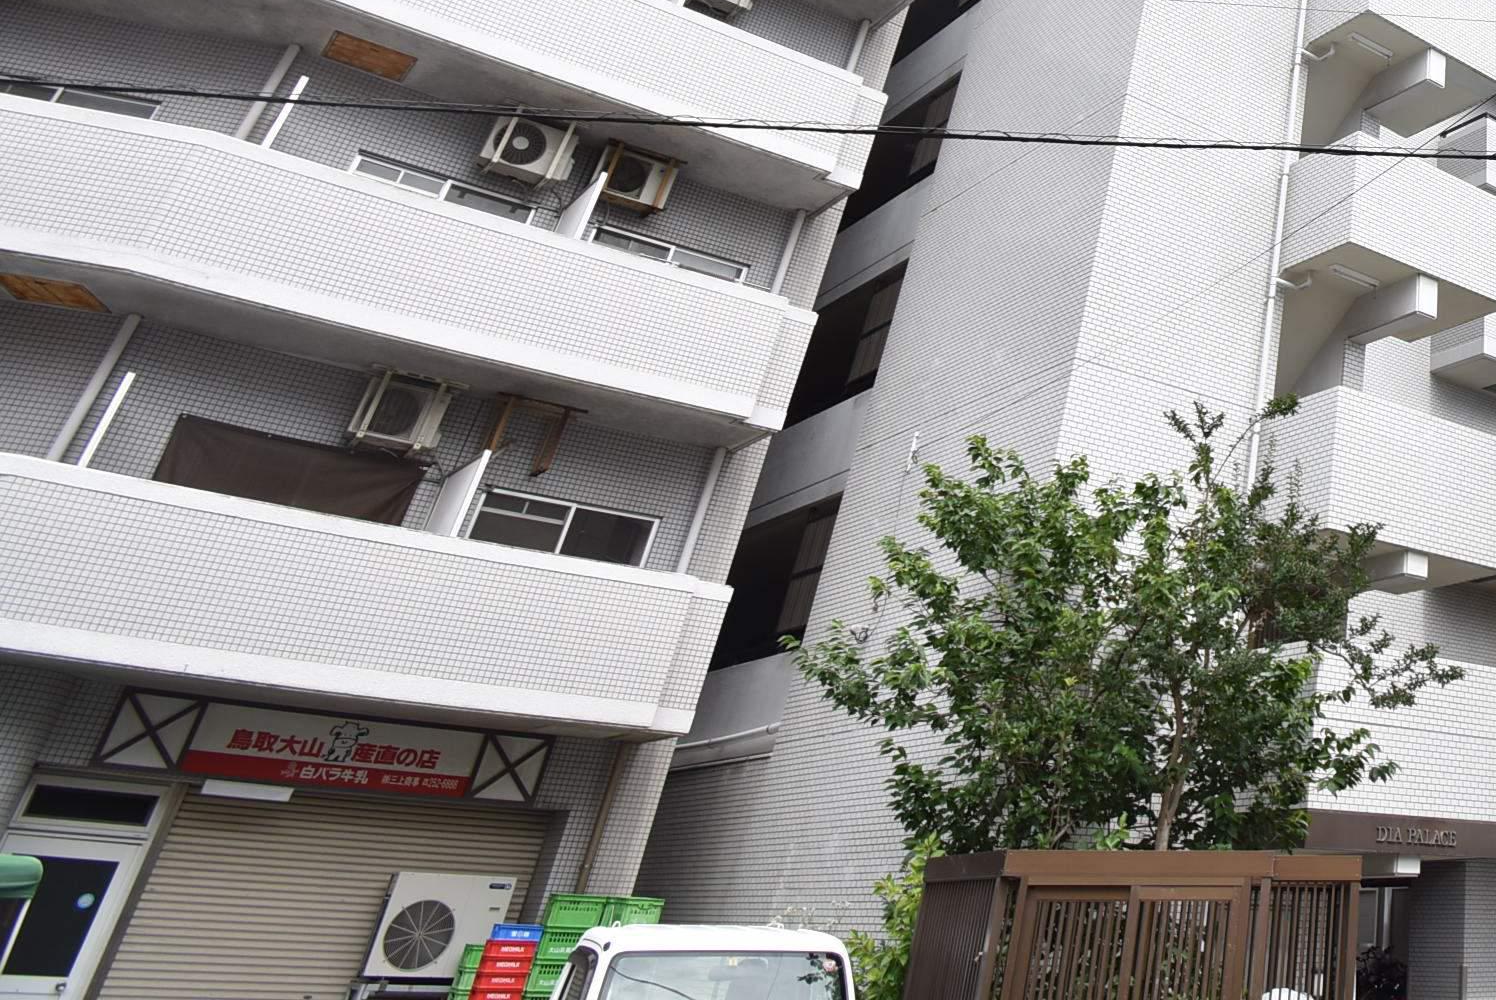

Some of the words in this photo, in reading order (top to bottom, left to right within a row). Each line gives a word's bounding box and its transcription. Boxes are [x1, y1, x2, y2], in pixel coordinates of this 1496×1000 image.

[227, 729, 324, 758] 鳥取大山
[352, 743, 441, 769] 産直の店
[300, 764, 369, 784] 白バラ牛乳
[1376, 826, 1403, 843] DIA
[1406, 828, 1457, 847] PALACE
